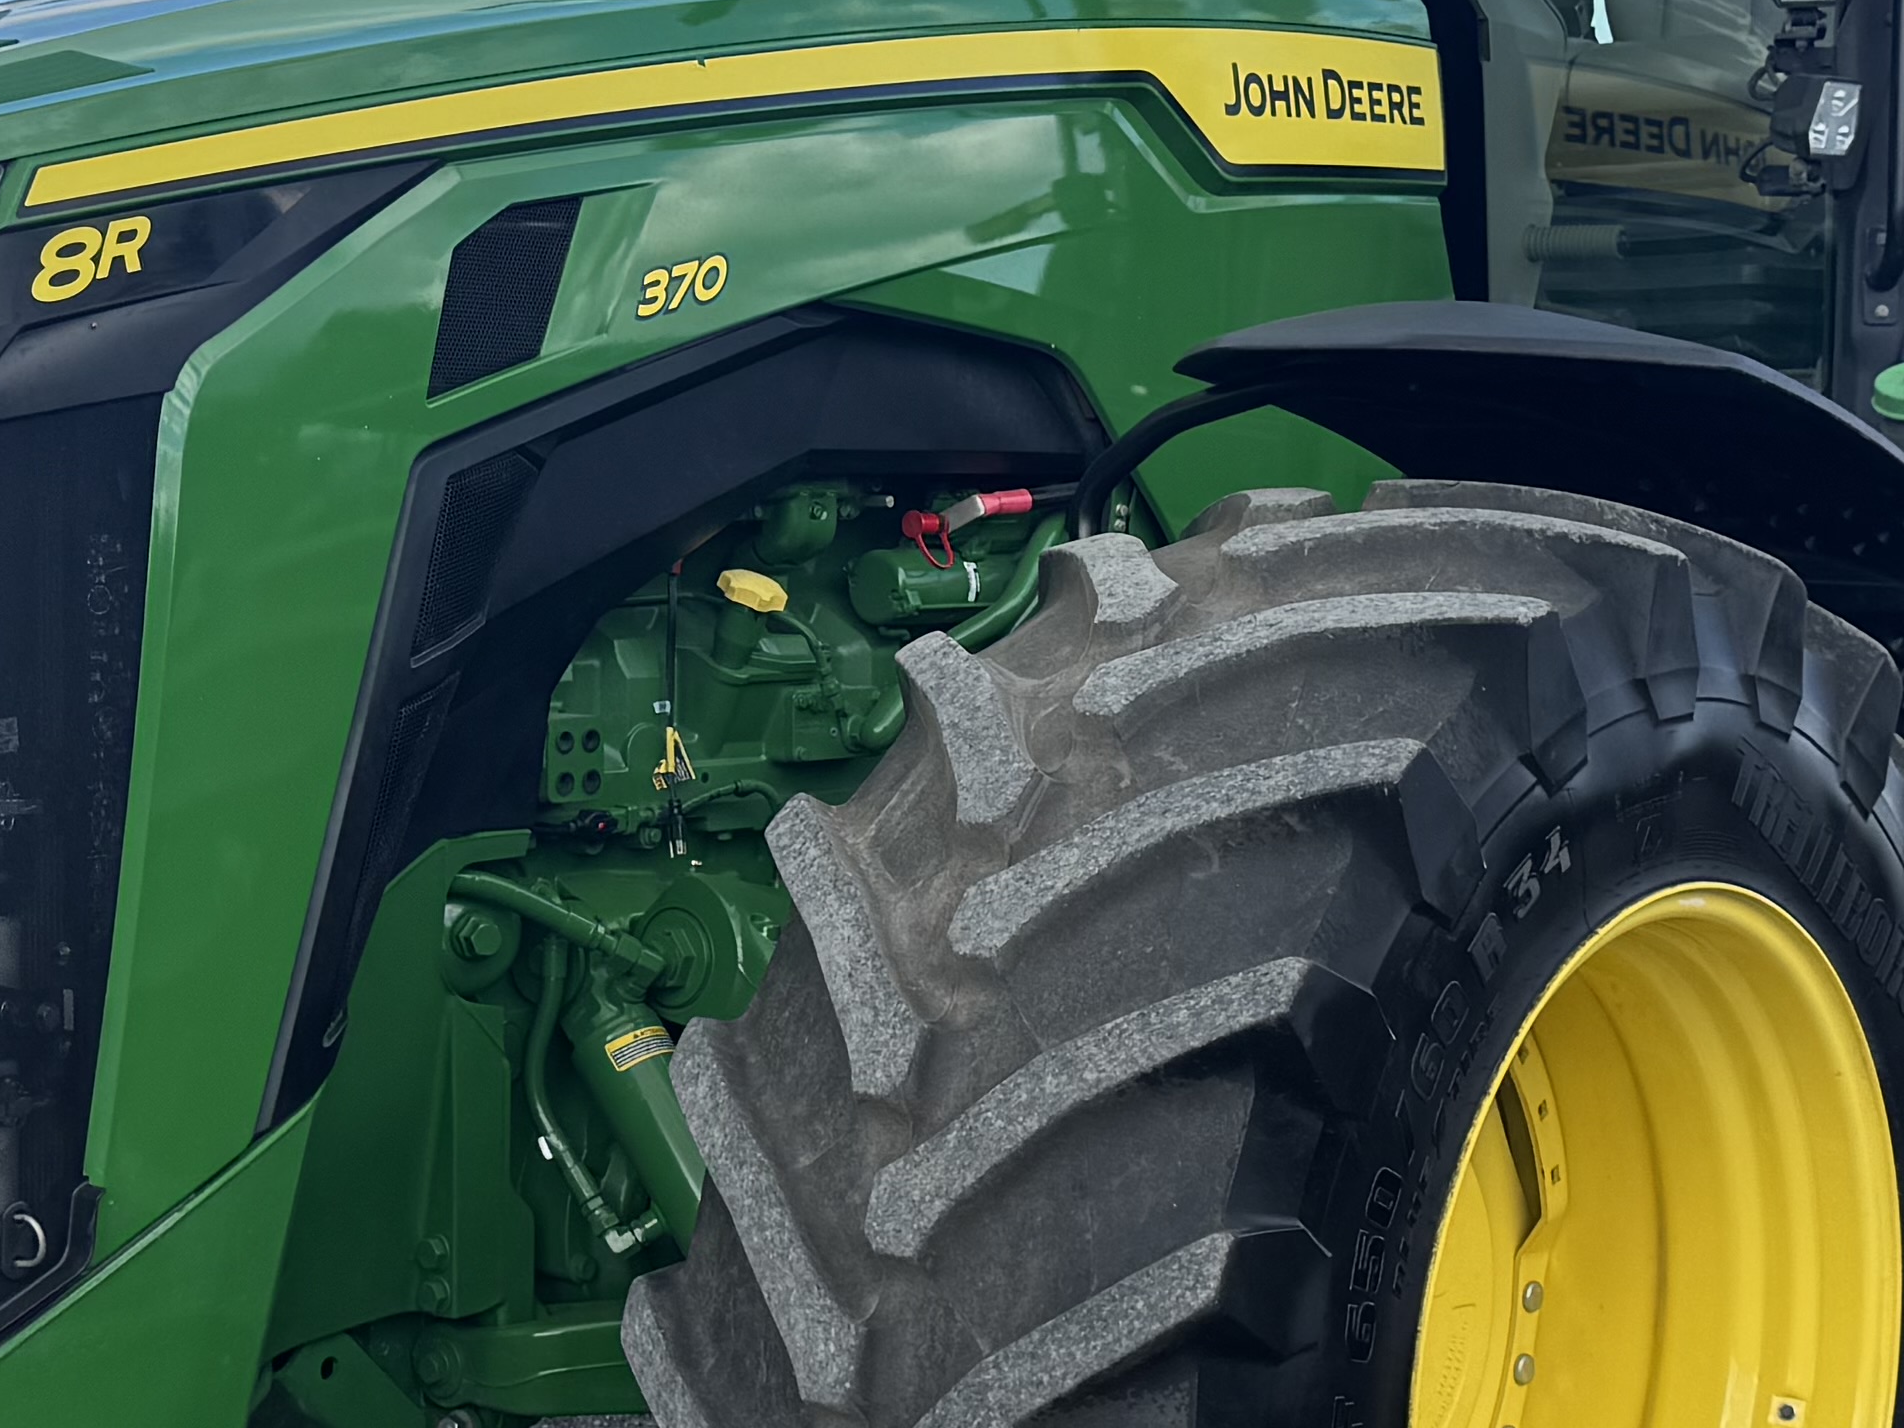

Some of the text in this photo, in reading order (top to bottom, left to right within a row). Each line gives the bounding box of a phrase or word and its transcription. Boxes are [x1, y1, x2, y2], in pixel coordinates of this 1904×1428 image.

[1224, 63, 1425, 126] JOHN DEERE
[31, 216, 151, 303] 8R
[637, 255, 728, 318] 370
